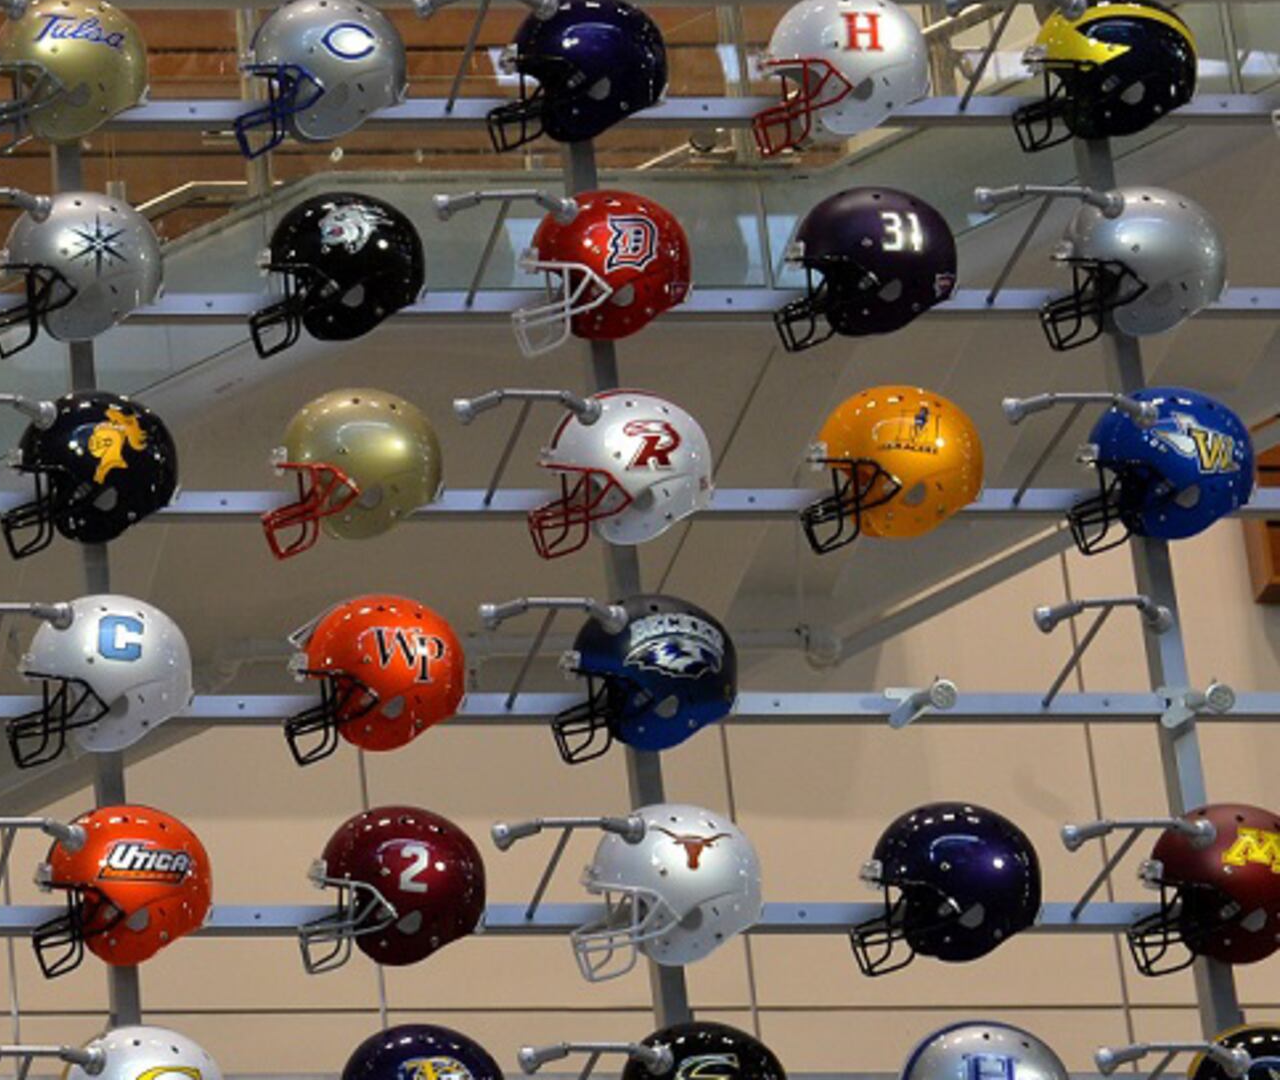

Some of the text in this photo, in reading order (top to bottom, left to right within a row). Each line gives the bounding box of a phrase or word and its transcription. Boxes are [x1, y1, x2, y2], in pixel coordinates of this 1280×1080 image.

[33, 15, 124, 48] Tulsa
[321, 23, 375, 59] C
[841, 13, 883, 51] H
[607, 216, 658, 272] D
[881, 212, 923, 252] 31
[99, 614, 145, 661] C
[398, 845, 430, 892] 2
